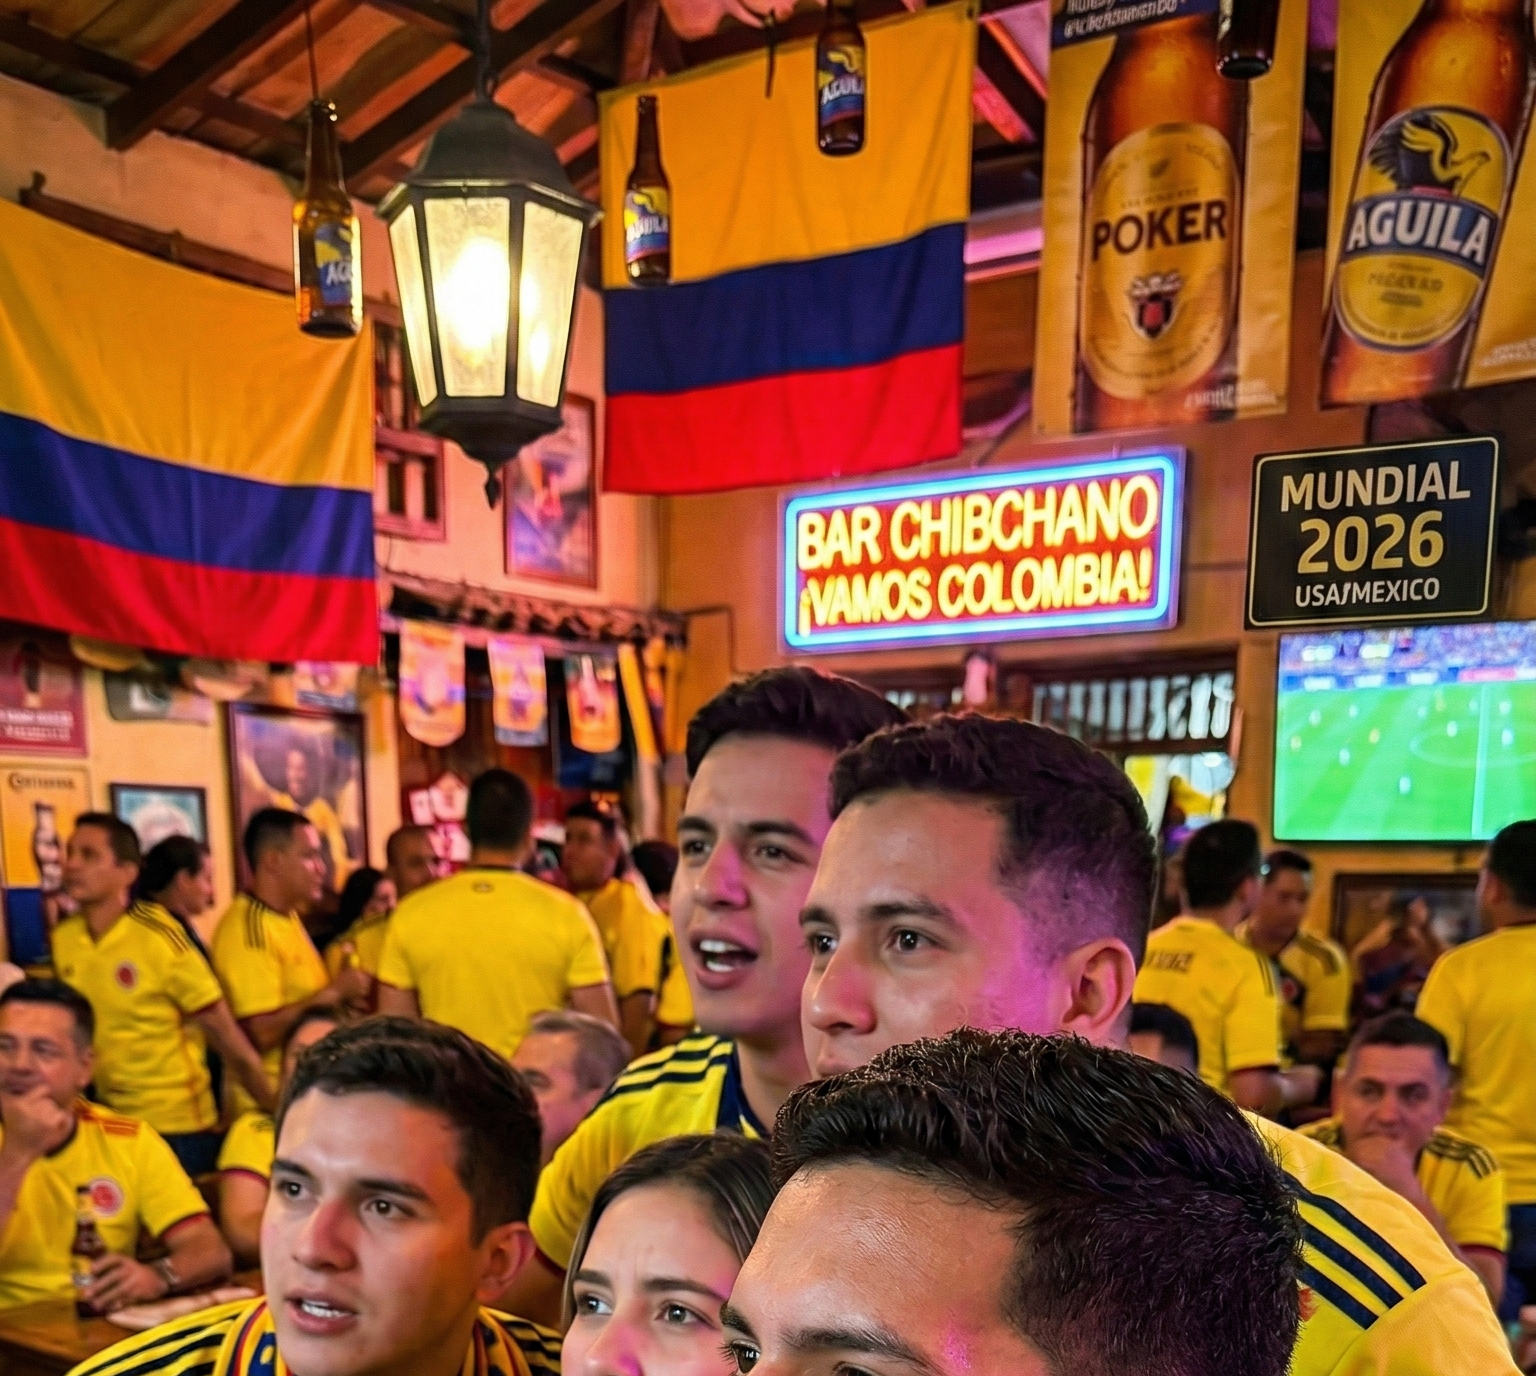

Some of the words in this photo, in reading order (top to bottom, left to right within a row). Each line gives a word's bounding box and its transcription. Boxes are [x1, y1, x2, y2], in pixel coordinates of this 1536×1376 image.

[1092, 199, 1226, 262] POKER
[1347, 201, 1491, 265] AGUILA
[1280, 460, 1471, 512] MUNDIAL
[798, 505, 883, 571] BAR
[890, 474, 1159, 562] CHIBCHANO
[1297, 510, 1445, 574] 2026
[799, 567, 933, 637] ¡VAMOS
[938, 547, 1153, 618] COLOMBIA!
